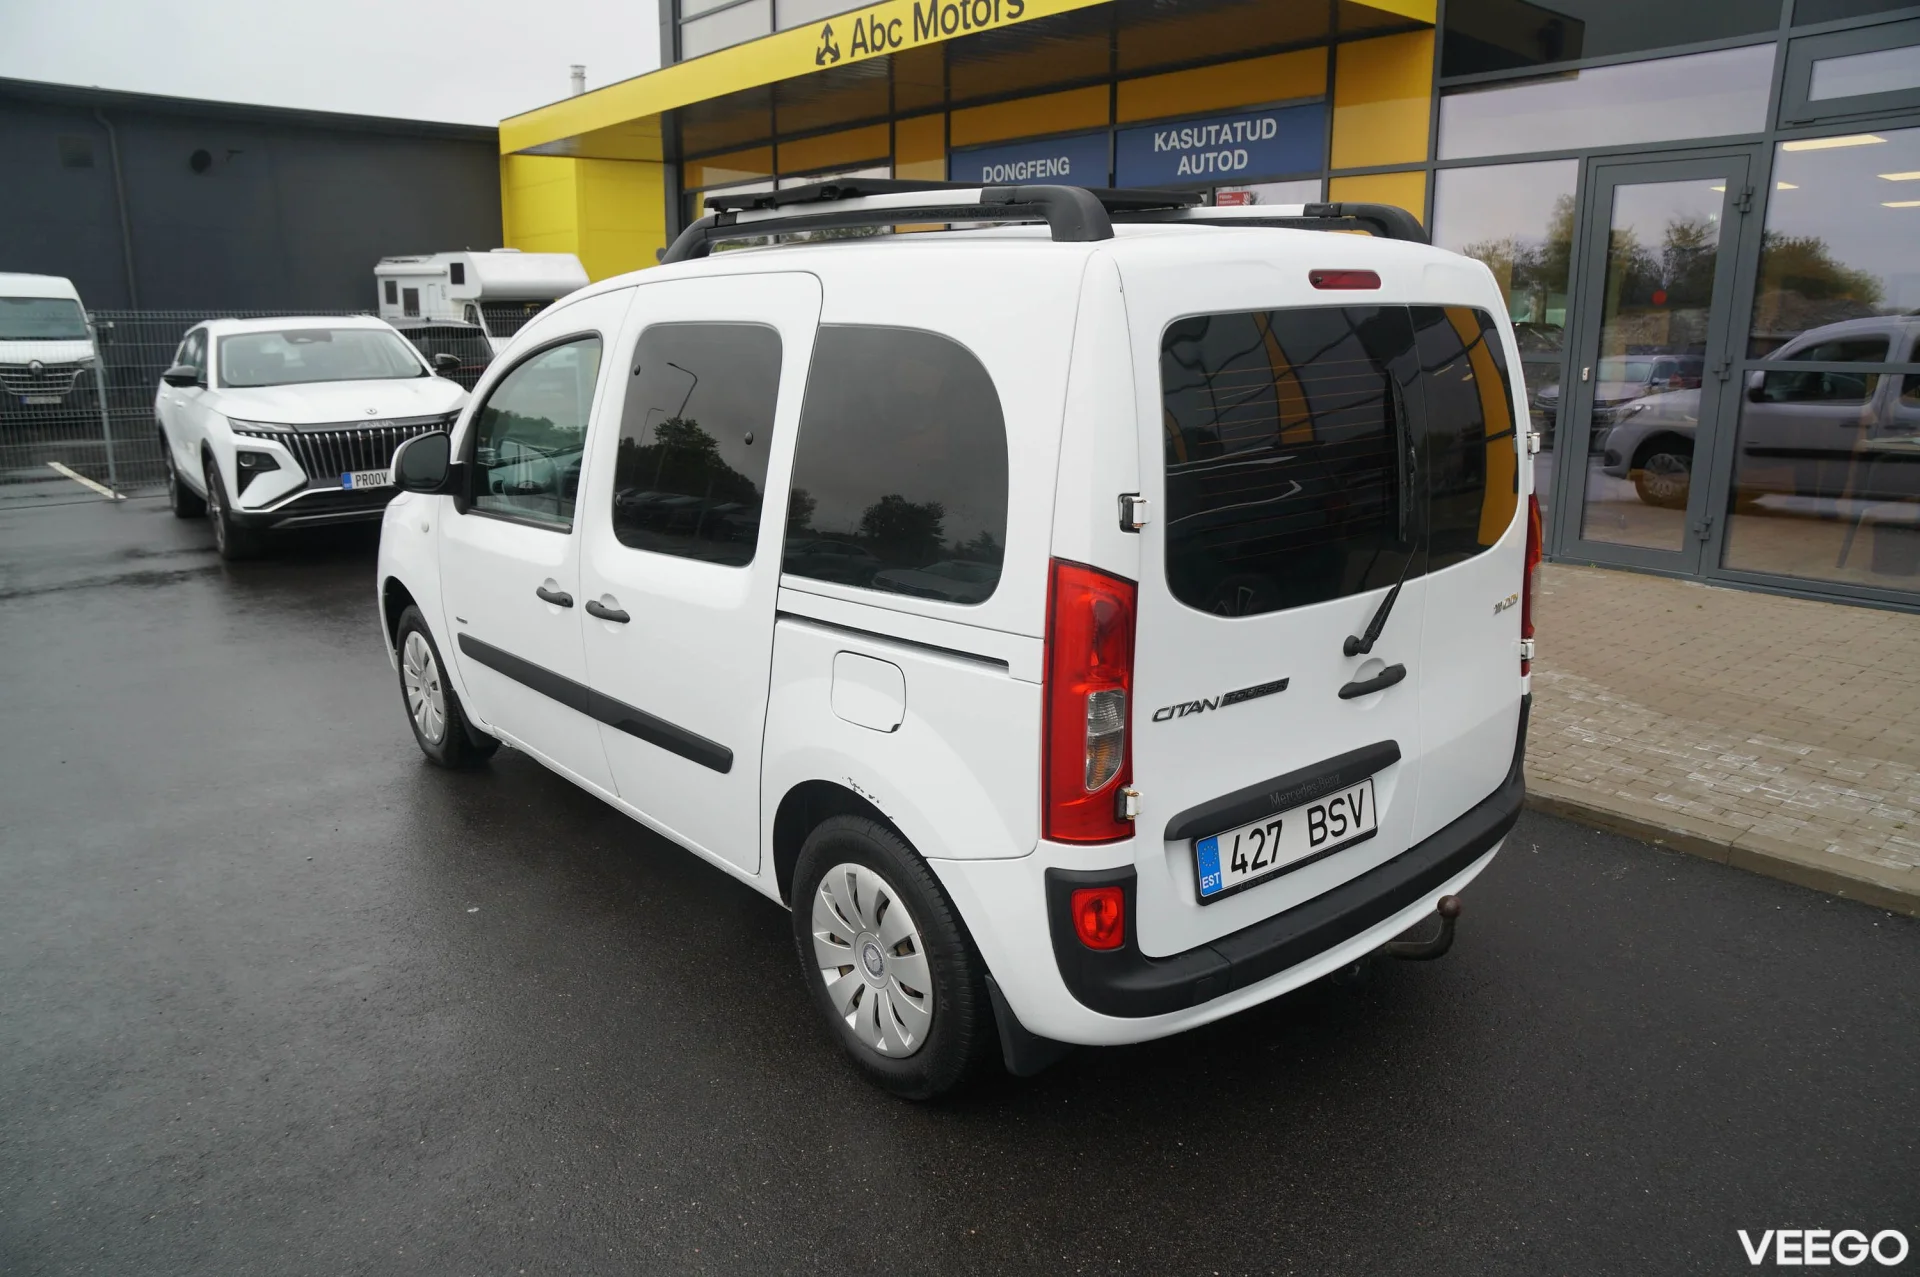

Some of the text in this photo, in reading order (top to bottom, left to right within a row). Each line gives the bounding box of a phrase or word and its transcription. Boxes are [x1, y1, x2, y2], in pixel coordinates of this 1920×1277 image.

[850, 0, 1025, 58] Abc Motors
[1154, 118, 1277, 152] KASUTATUD
[982, 156, 1070, 184] DONGFENG
[1177, 149, 1249, 176] AUTOD
[355, 472, 388, 487] PROOV
[1151, 679, 1287, 722] CITAN TOURER
[1230, 788, 1364, 875] 427 BSV
[1202, 872, 1221, 889] EST
